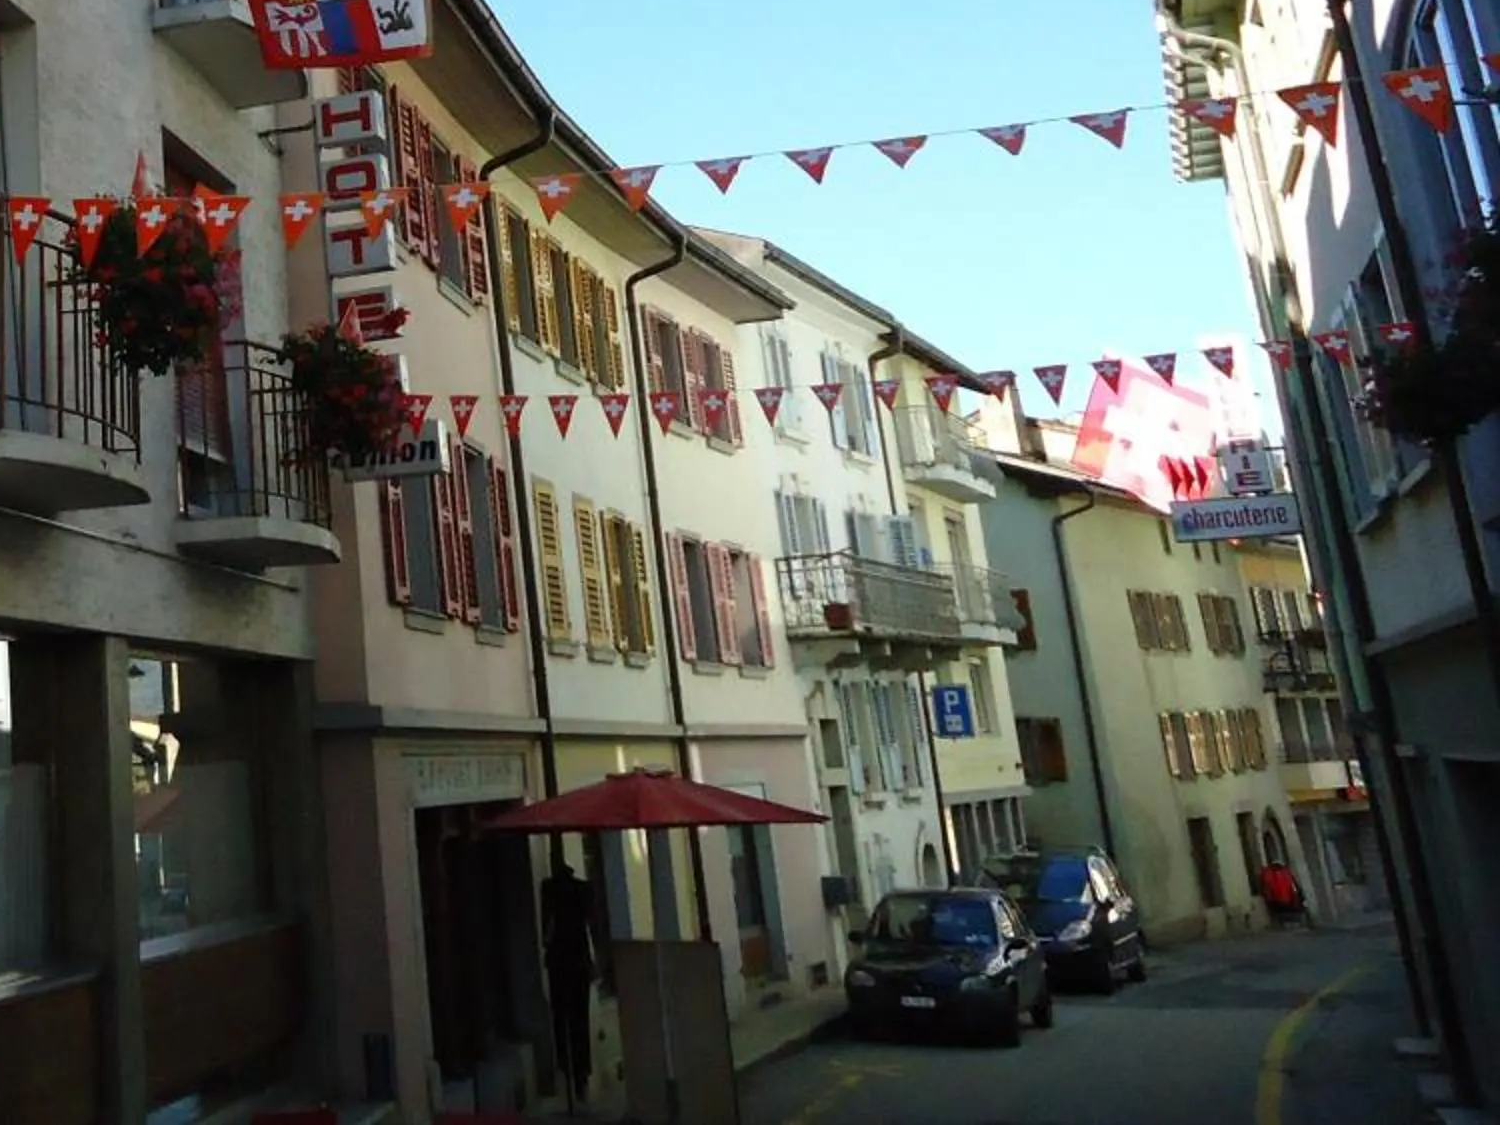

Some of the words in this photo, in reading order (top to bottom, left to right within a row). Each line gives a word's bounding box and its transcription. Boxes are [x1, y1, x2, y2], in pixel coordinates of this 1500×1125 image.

[321, 97, 394, 342] HOTE
[1182, 506, 1288, 532] charcuterie
[943, 690, 960, 713] P
